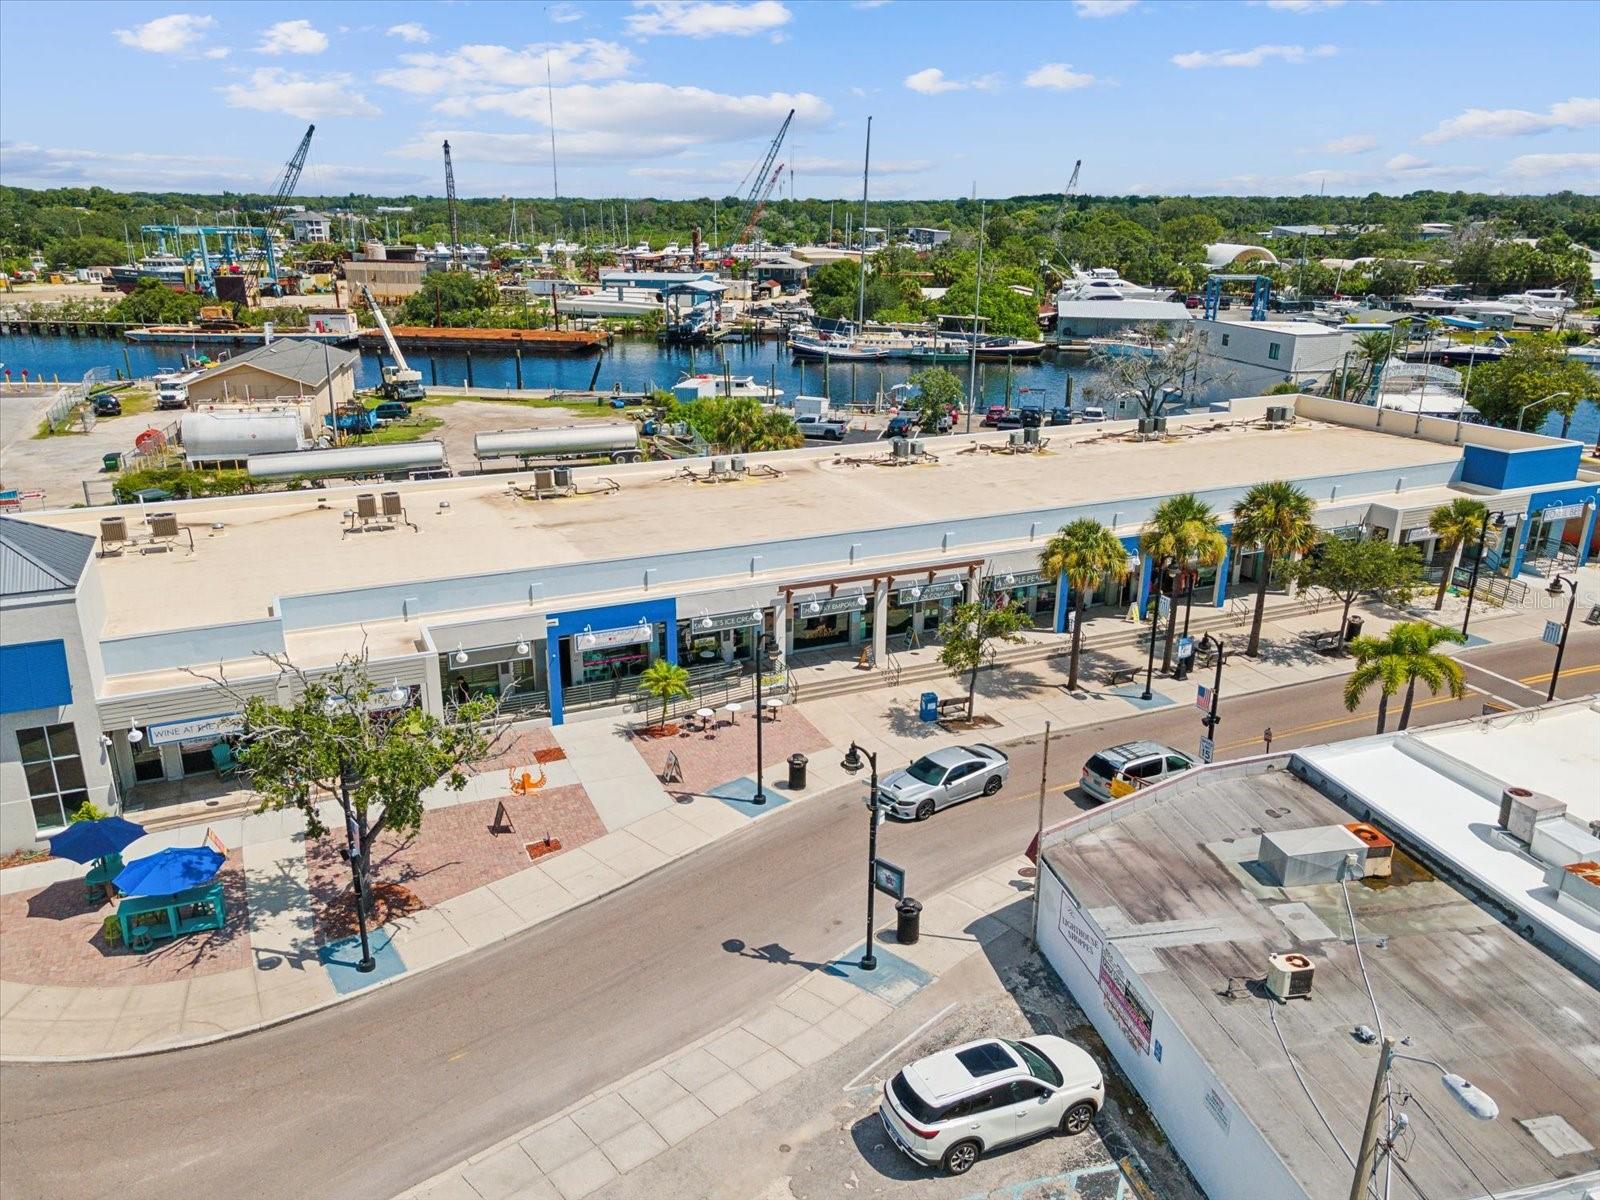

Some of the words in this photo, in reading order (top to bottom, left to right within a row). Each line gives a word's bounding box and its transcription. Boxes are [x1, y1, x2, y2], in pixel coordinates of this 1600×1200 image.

[154, 728, 181, 738] WINE
[183, 726, 194, 734] AT
[1202, 749, 1211, 760] 15
[1062, 917, 1100, 949] LIGHTHOUSE
[1067, 930, 1094, 955] SHOPPES
